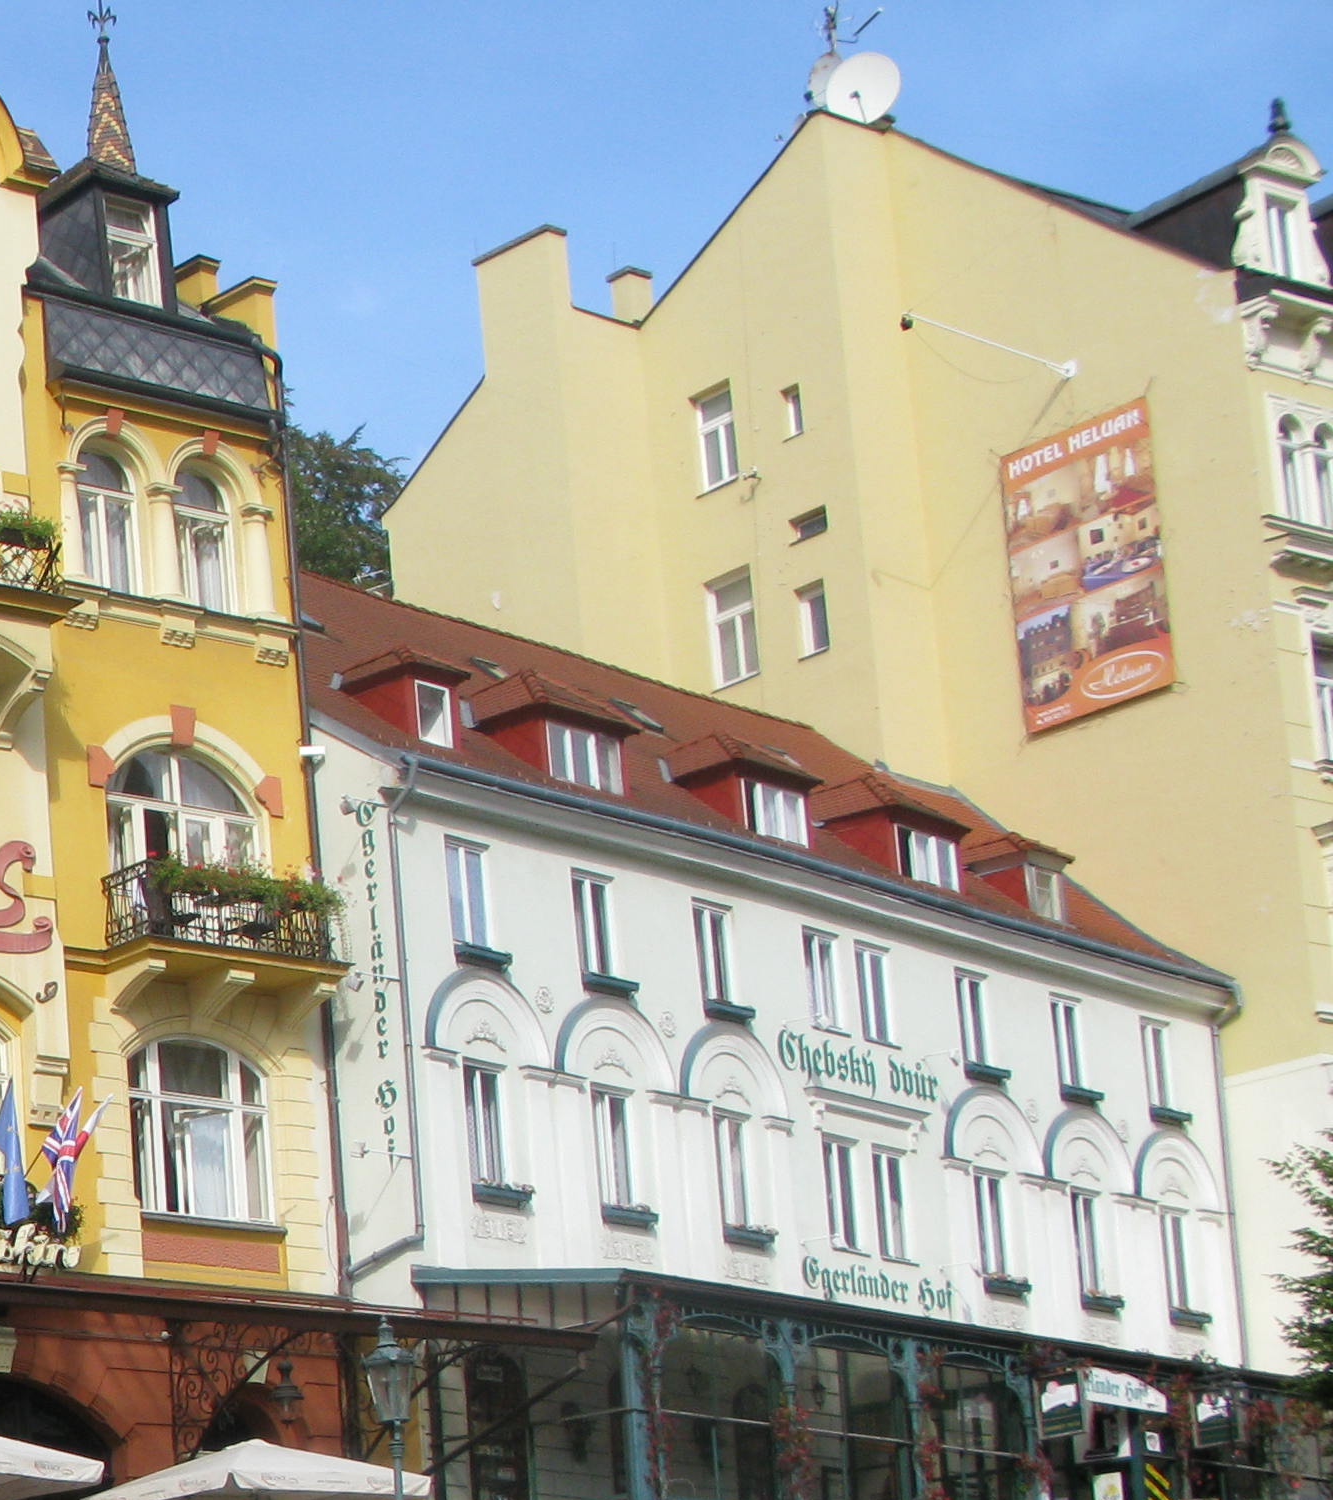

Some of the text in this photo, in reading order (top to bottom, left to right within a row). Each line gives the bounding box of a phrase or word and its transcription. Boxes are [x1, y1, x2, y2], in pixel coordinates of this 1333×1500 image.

[1008, 408, 1142, 479] HOTEL HELUAN
[777, 1029, 876, 1098] Chebský
[802, 1256, 909, 1304] Egerländer
